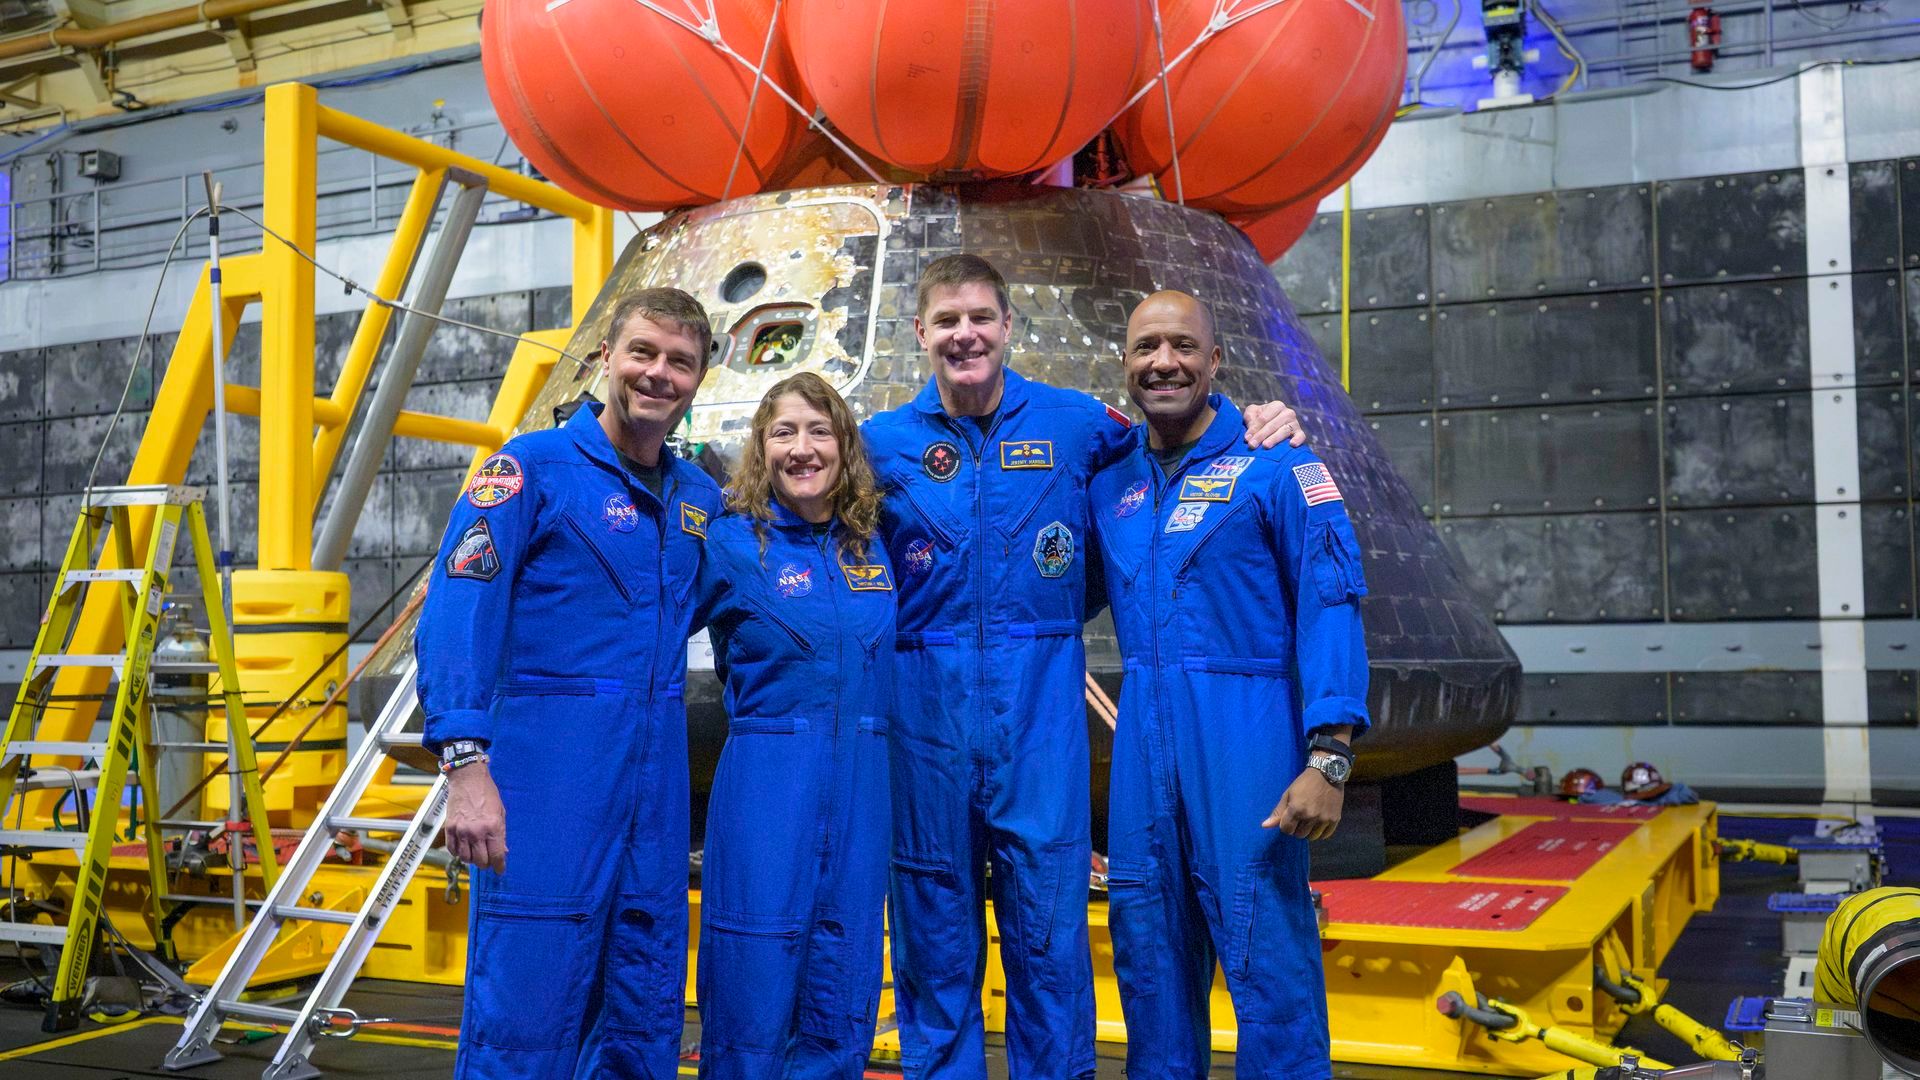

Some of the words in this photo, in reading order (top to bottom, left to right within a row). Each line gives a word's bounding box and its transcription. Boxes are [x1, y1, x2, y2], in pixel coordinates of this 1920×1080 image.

[607, 506, 637, 519] NASA
[905, 551, 934, 562] NASA
[779, 575, 811, 586] NASA
[408, 845, 421, 861] FOR
[398, 861, 412, 879] USE
[392, 879, 401, 891] AT
[381, 891, 395, 909] SEA
[69, 934, 87, 990] WERNER
